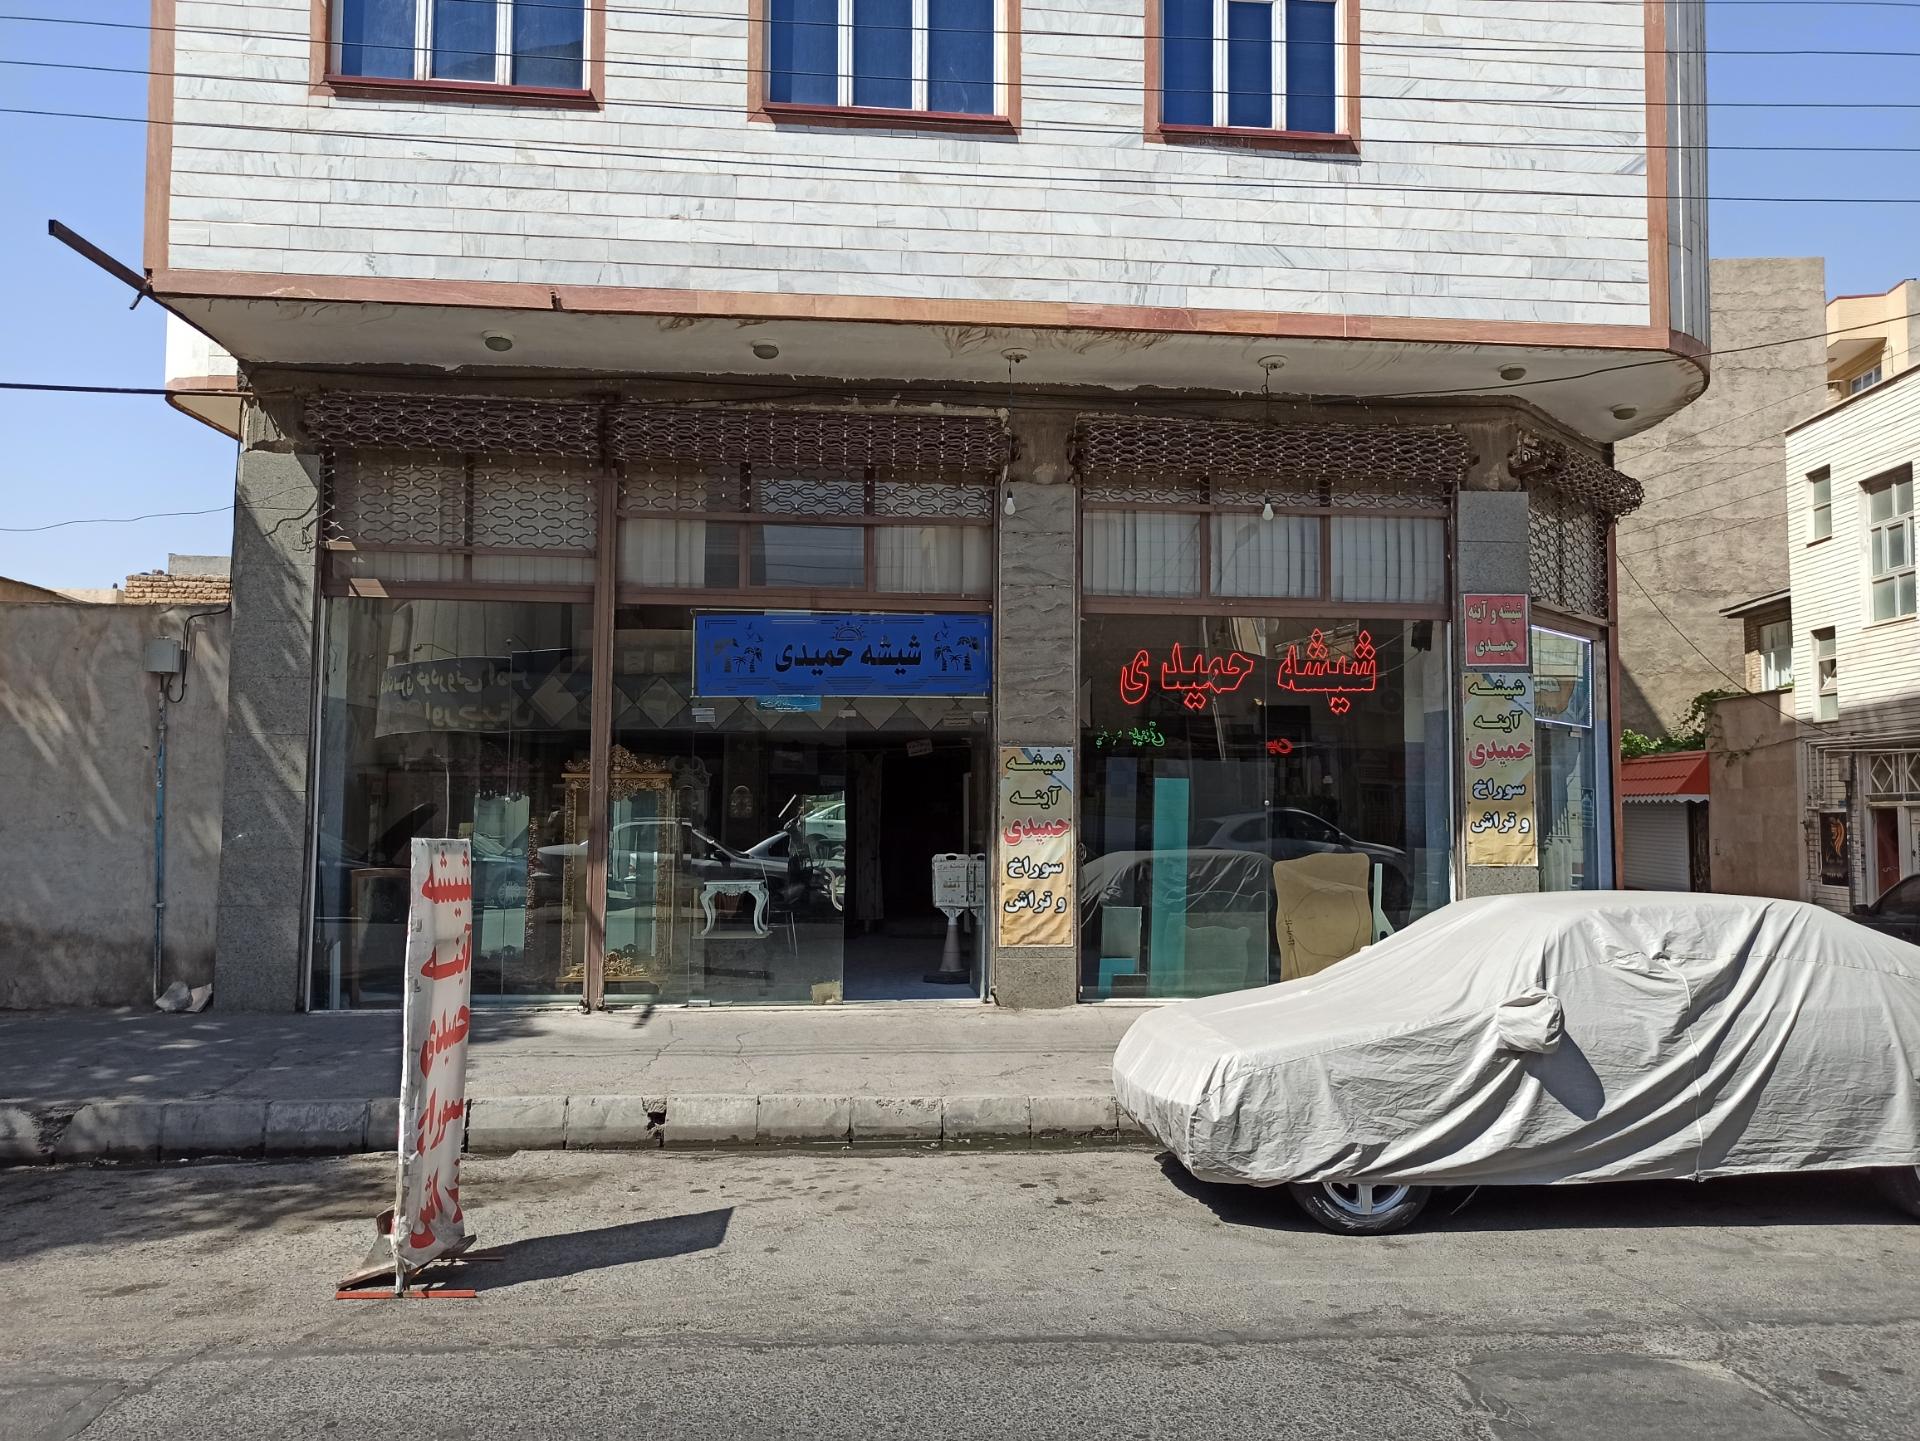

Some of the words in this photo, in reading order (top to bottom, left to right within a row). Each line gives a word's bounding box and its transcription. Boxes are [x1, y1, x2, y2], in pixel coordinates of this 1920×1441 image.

[1468, 600, 1488, 622] آینه
[1490, 609, 1497, 625] و
[1498, 601, 1523, 621] شیشه
[775, 643, 854, 676] حمیدی
[860, 633, 923, 676] شیشه
[1474, 639, 1518, 657] حمیدی
[1120, 642, 1254, 709] حمیدی
[1278, 628, 1376, 714] شیشه
[1468, 679, 1525, 699] شیشه
[1473, 710, 1522, 733] آینه
[1005, 753, 1066, 776] شیشه
[1468, 738, 1532, 769] حمیدی
[1009, 786, 1063, 810] آینه
[1472, 778, 1526, 800] سوراخ
[1003, 816, 1071, 847] حمیدی
[1470, 811, 1516, 834] تراش
[1519, 817, 1531, 834] و
[1007, 855, 1064, 880] سوراخ
[421, 850, 472, 918] شیشه
[1004, 889, 1053, 914] تراش
[1055, 896, 1067, 914] و
[420, 1004, 470, 1080] حمیدی
